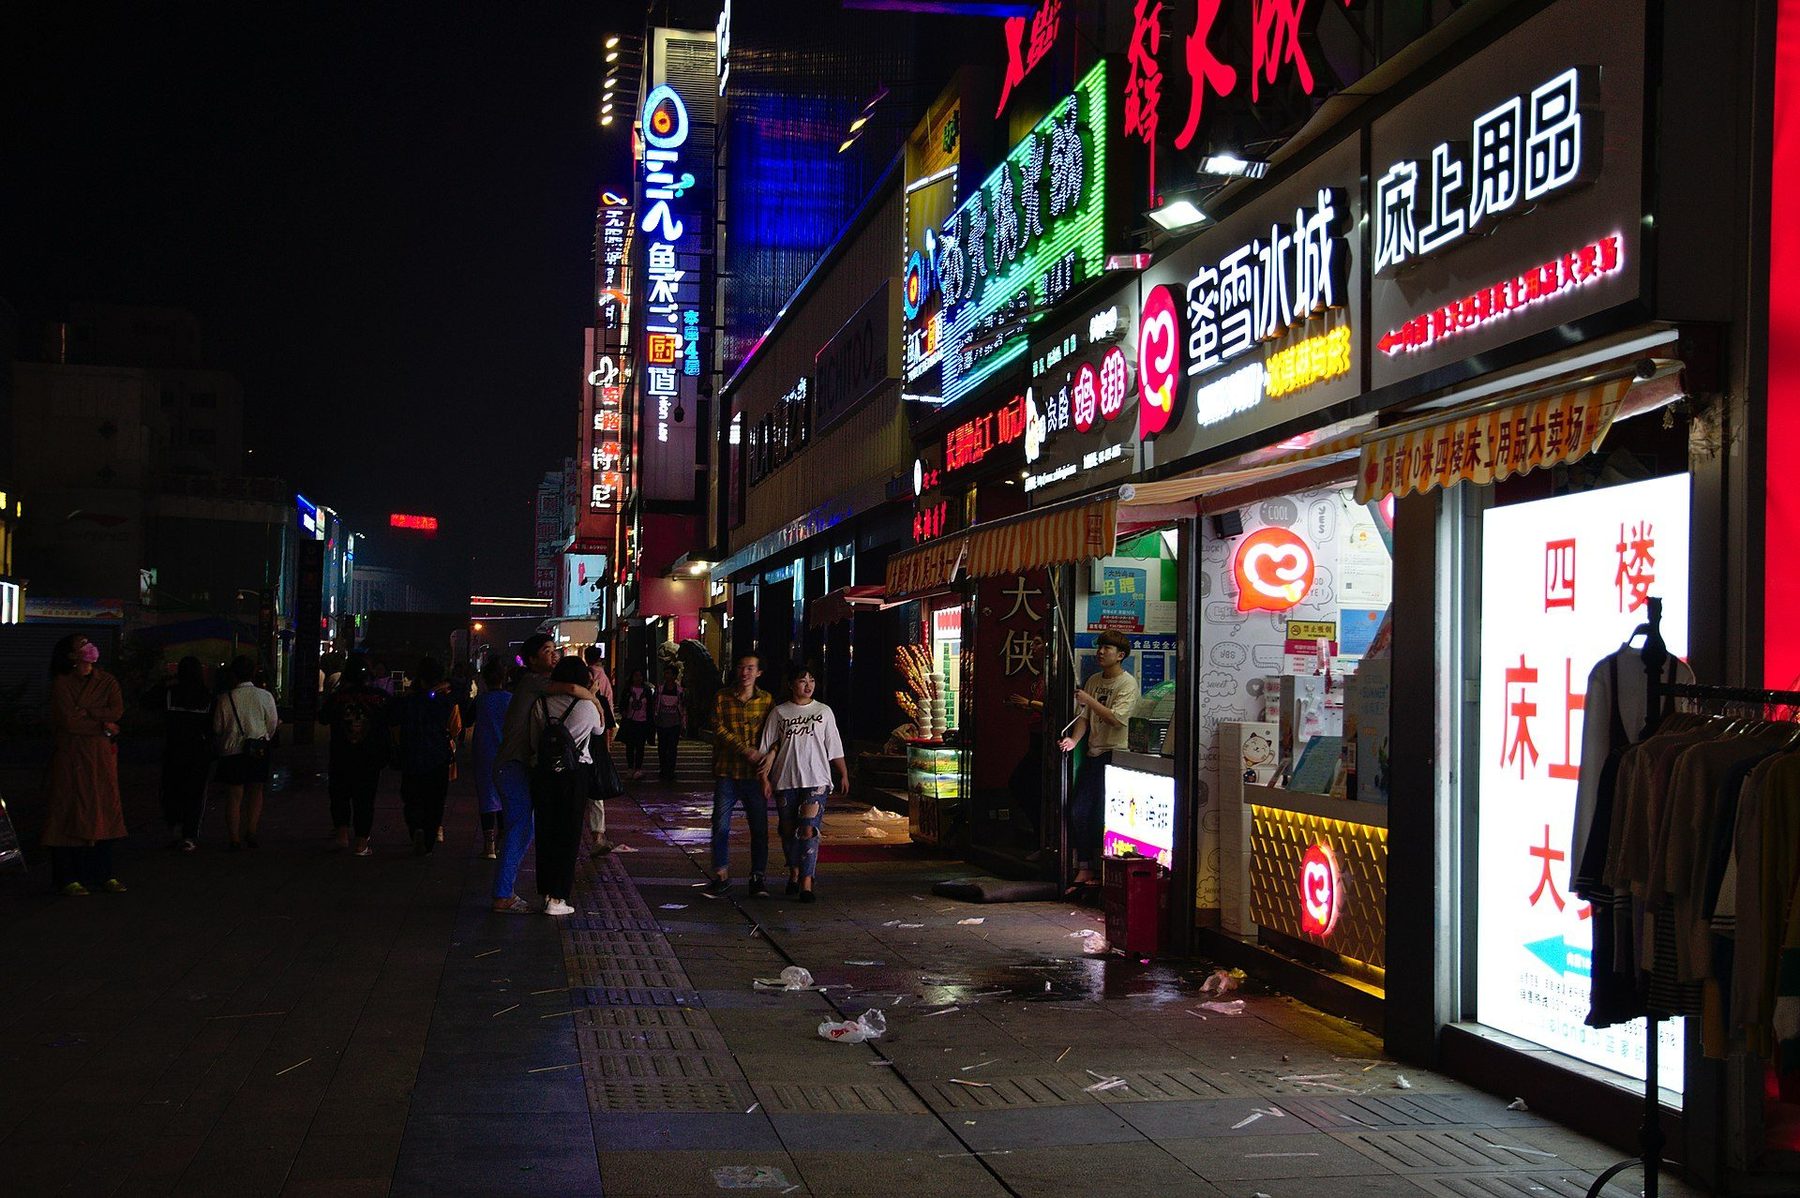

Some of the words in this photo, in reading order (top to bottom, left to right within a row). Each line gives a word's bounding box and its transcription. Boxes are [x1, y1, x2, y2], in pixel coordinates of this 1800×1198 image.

[1374, 67, 1581, 275] 床上用品
[1187, 188, 1334, 376] 蜜雪冰城
[1383, 405, 1584, 488] 向前10米四楼床上用品大卖场
[1268, 506, 1288, 520] COOL
[1545, 520, 1655, 613] 四楼
[1000, 576, 1042, 676] 大侠
